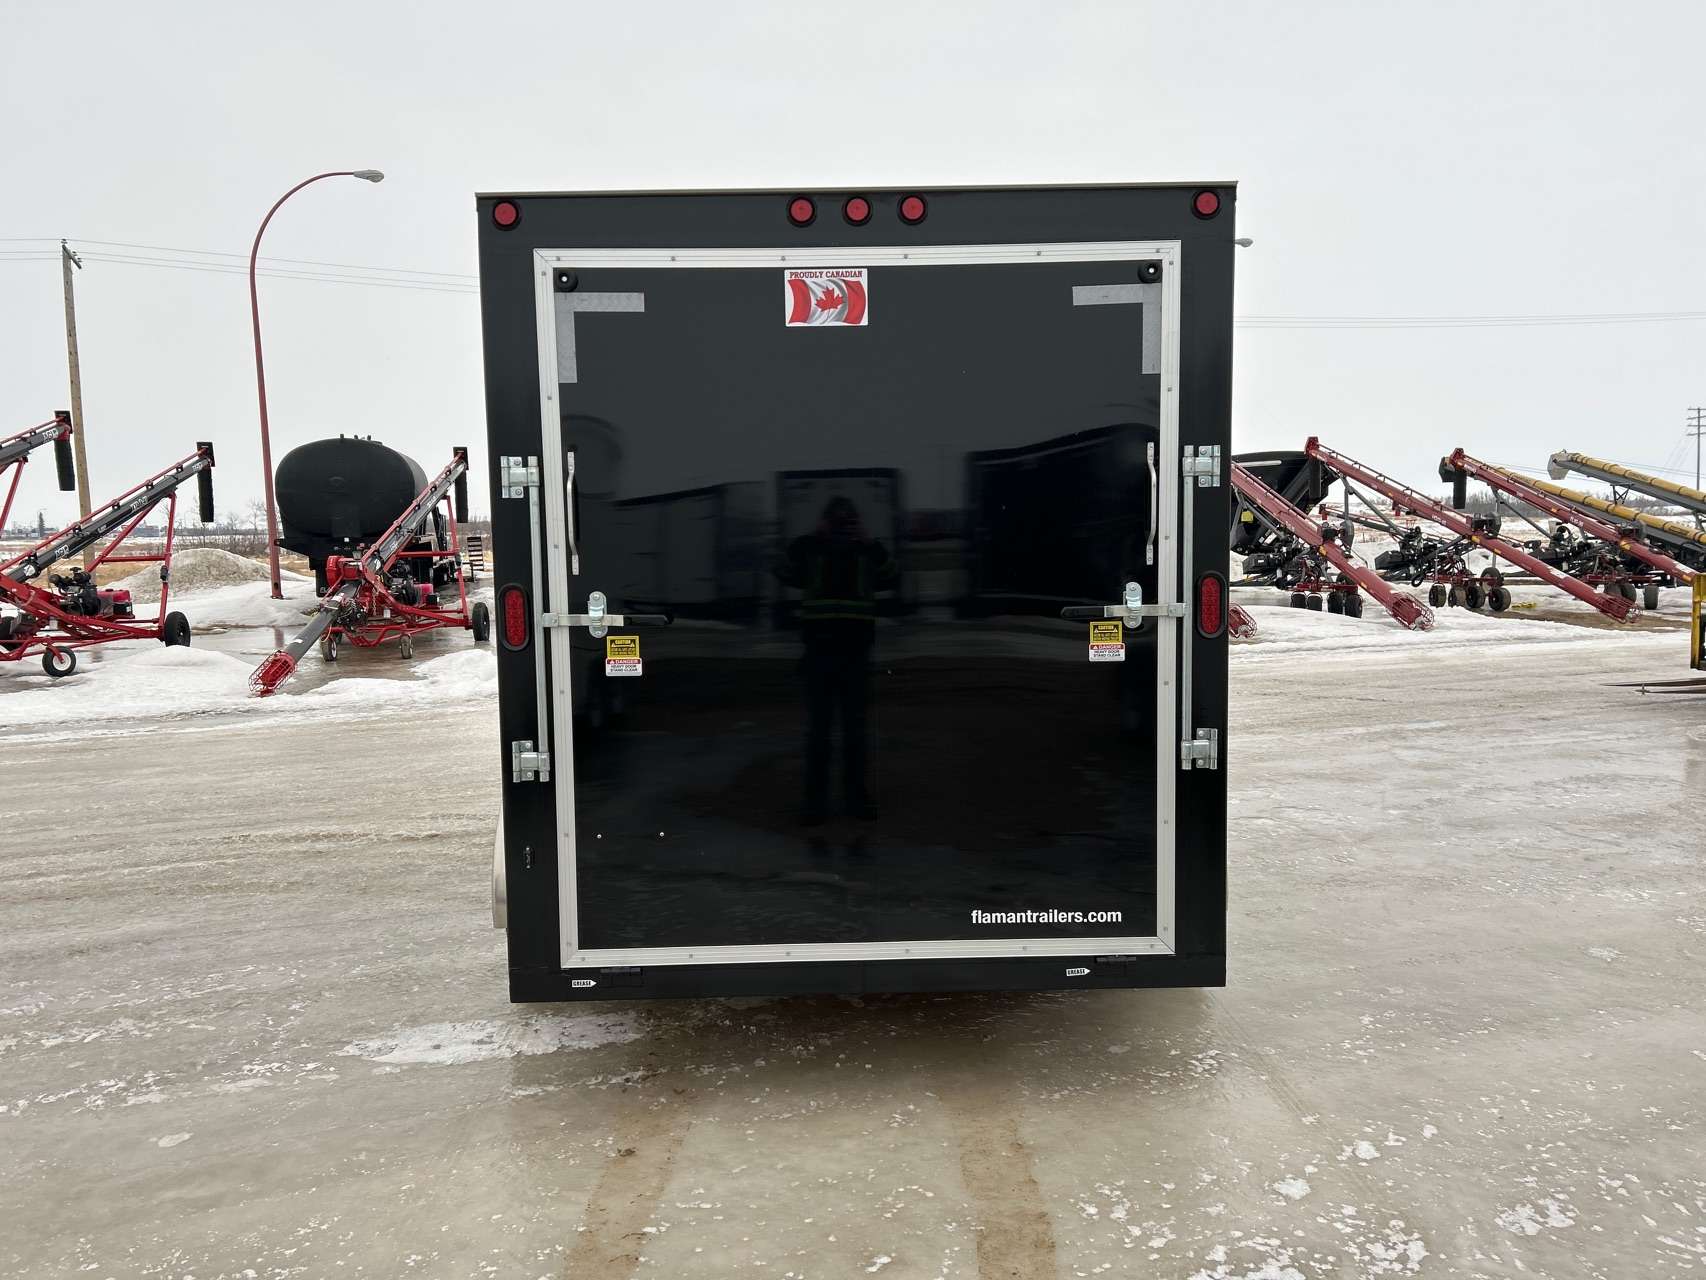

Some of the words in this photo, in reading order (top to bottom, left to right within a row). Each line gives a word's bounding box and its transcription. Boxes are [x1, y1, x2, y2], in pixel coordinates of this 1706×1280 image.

[789, 271, 824, 279] PROUDLY
[825, 270, 863, 279] CANADIAN
[971, 909, 1122, 924] flamantrailers.com
[1067, 968, 1086, 976] GREASE
